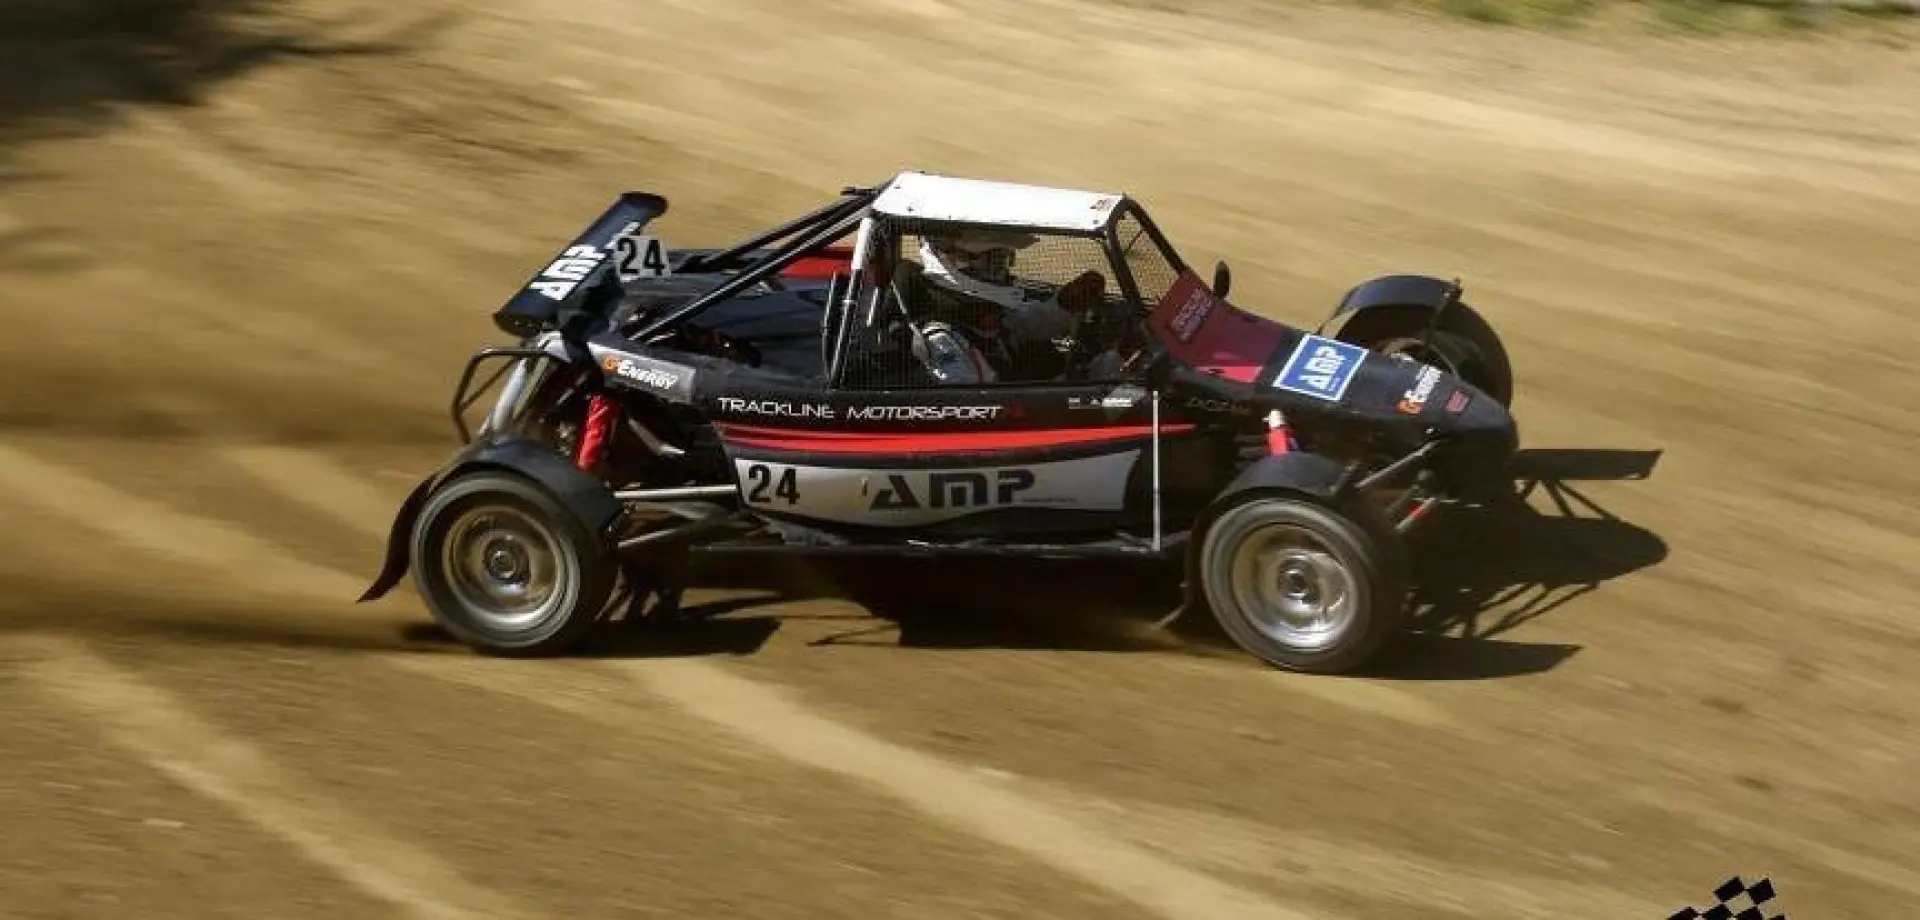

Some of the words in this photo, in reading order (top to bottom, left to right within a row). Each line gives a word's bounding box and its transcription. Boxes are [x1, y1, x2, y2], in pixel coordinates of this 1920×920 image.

[617, 237, 665, 277] 24
[717, 397, 835, 419] TRACKLINE
[846, 404, 1003, 420] MOTORSPORT
[748, 463, 801, 505] 24
[869, 470, 1035, 510] AMP
